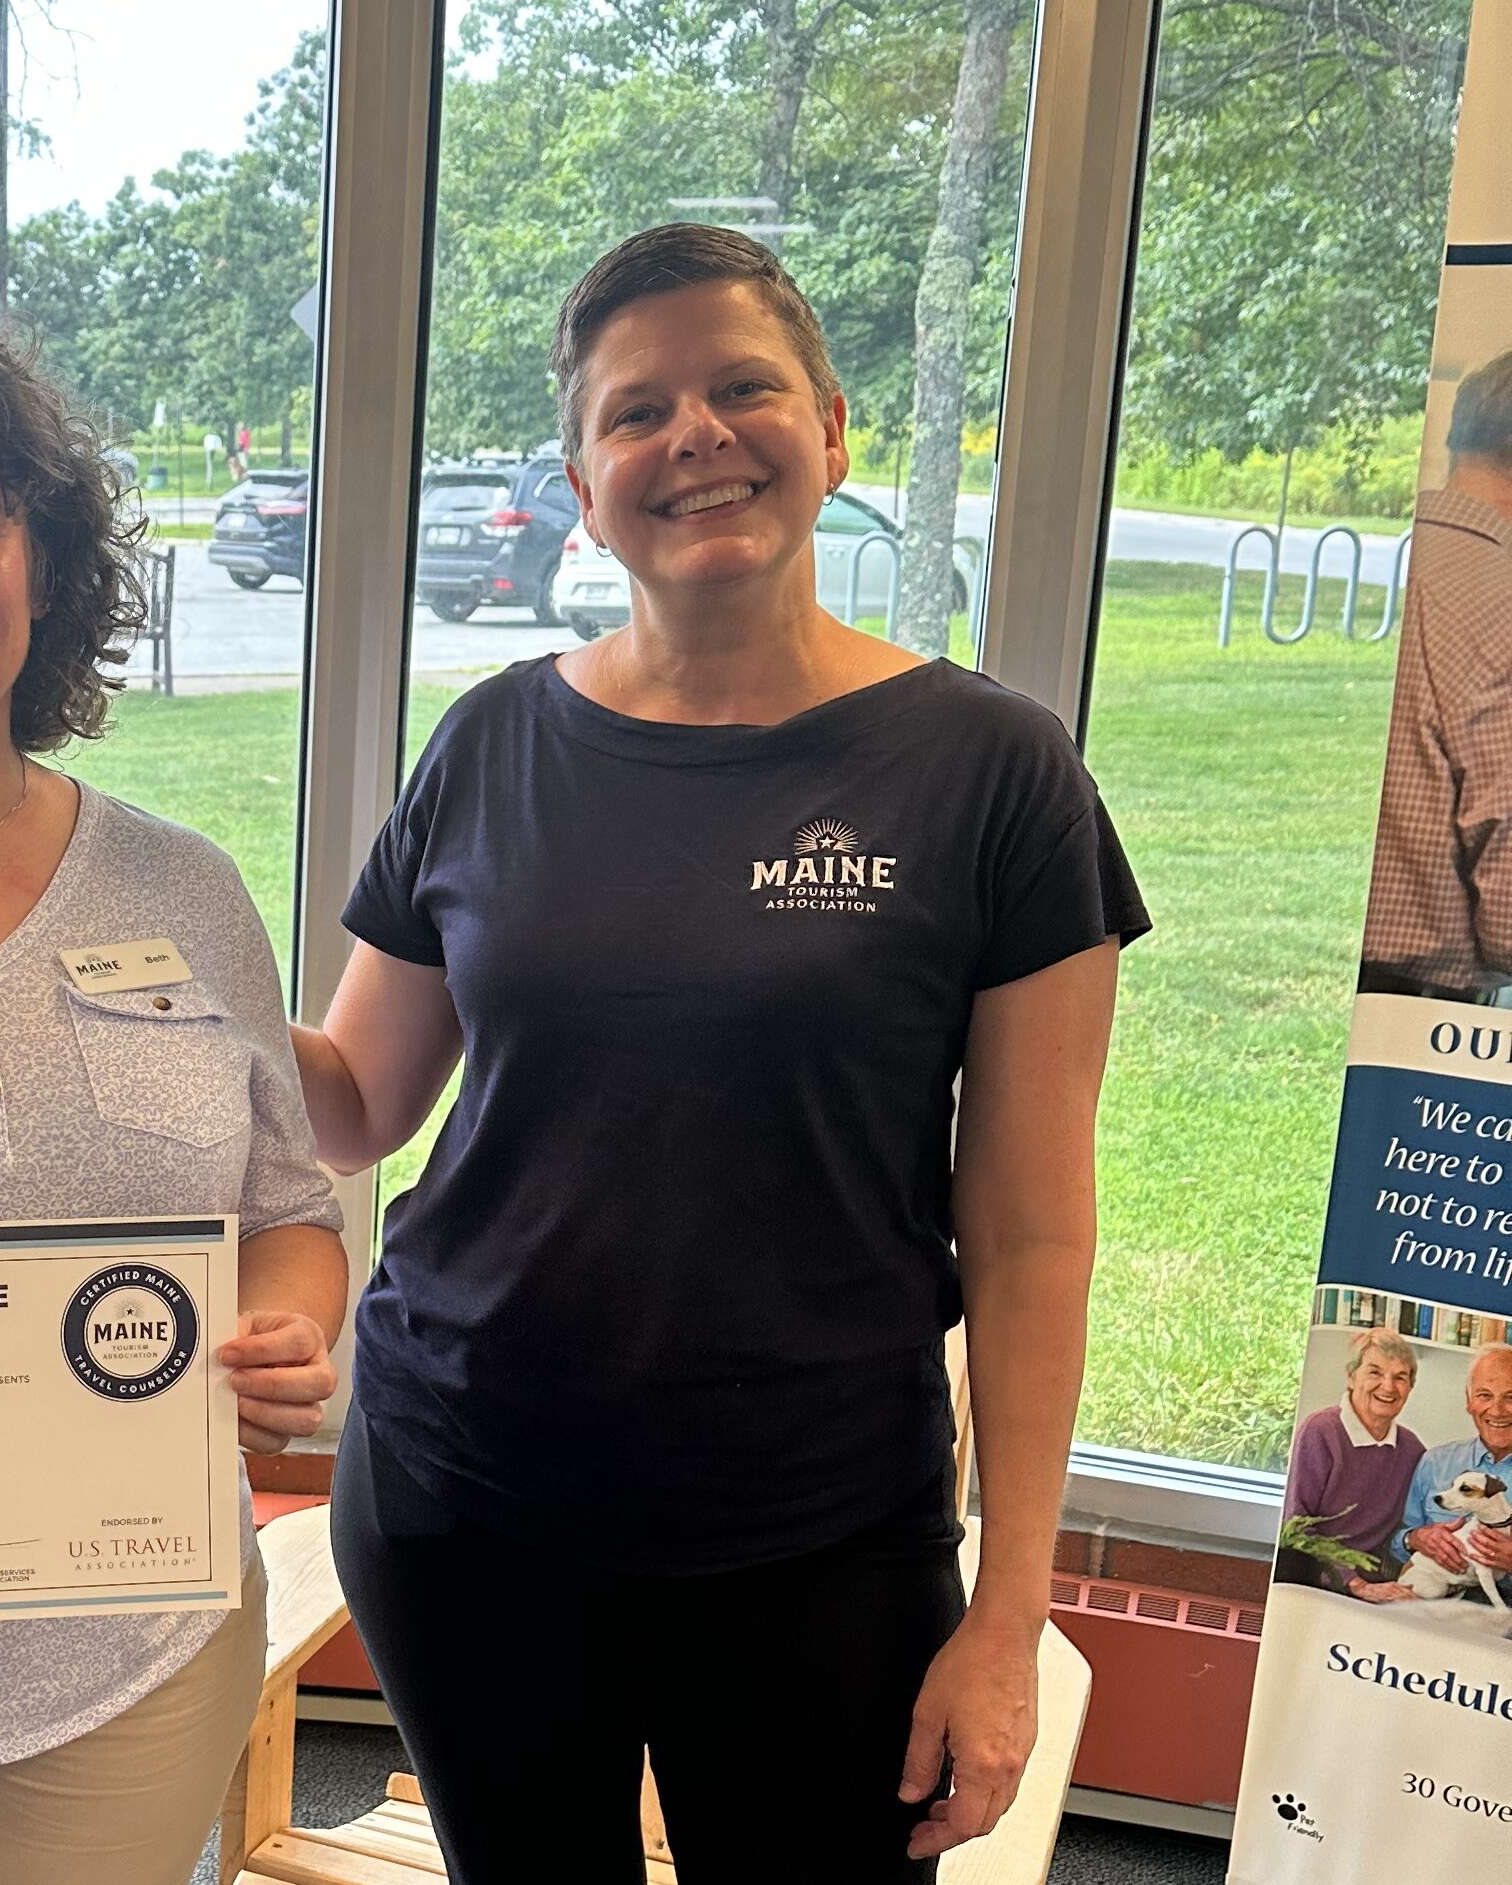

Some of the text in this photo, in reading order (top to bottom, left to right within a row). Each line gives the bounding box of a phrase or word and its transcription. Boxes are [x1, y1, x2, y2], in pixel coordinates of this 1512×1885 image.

[750, 855, 897, 890] MAINE
[788, 886, 859, 899] TOURISM
[765, 899, 877, 913] ASSOCIATION
[75, 960, 123, 977] MAINE
[144, 953, 171, 964] Beth
[1430, 1022, 1512, 1064] OU
[1384, 1136, 1504, 1185] here to
[1375, 1189, 1512, 1236] not to re
[1390, 1230, 1477, 1275] from
[80, 1270, 182, 1306] CERTIFIED MAINE
[93, 1321, 168, 1345] MAINE
[103, 1352, 158, 1360] ASSOCIATION
[74, 1350, 188, 1394] TRAVEL COUNSELOR
[101, 1516, 164, 1527] ENDORSED BY
[111, 1535, 198, 1556] TRAVEL
[0, 1568, 36, 1577] SERVICES
[1401, 1773, 1436, 1799] 30
